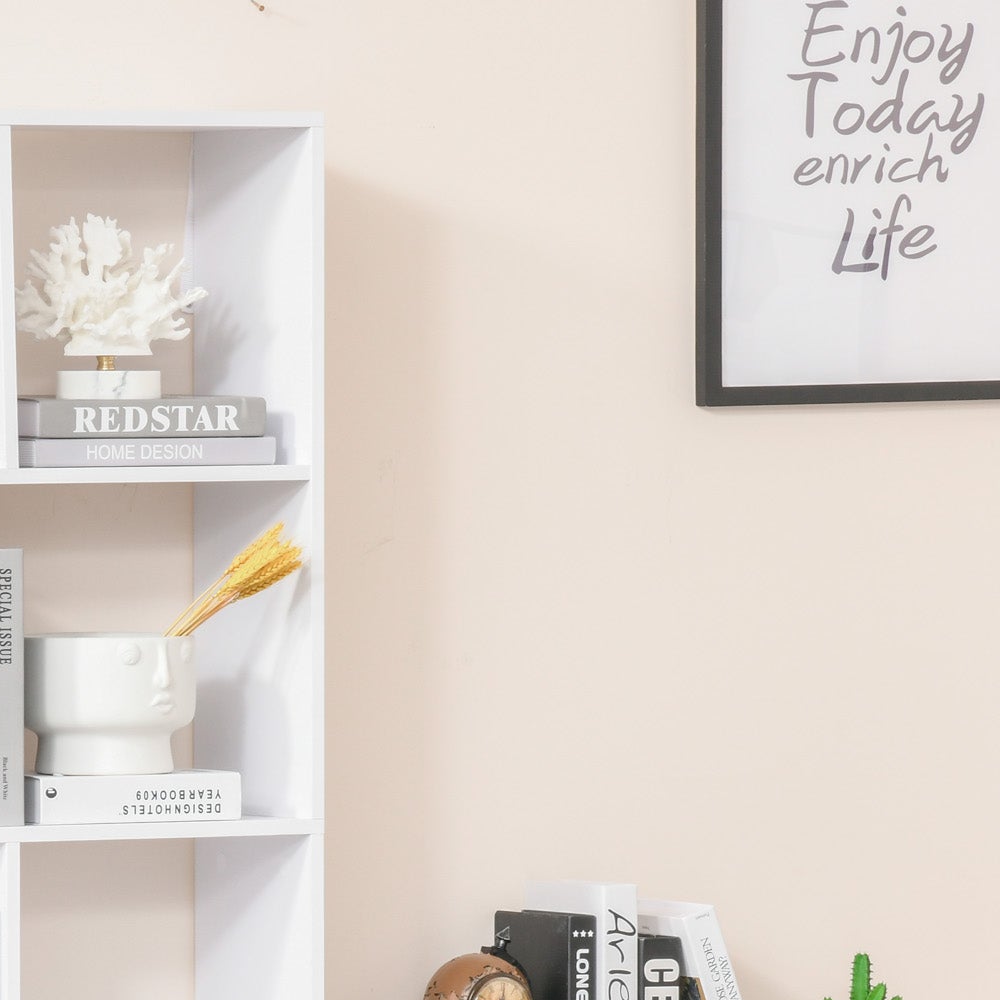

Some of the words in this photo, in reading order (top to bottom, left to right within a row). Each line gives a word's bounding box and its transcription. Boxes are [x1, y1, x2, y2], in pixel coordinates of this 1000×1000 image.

[801, 0, 974, 85] Enjoy
[787, 68, 985, 155] Today
[793, 133, 949, 186] enrich
[832, 193, 938, 281] Life
[73, 405, 240, 433] REDSTAR
[87, 445, 135, 460] HOME
[0, 568, 12, 623] SPECIAL
[0, 628, 12, 665] ISSUE
[122, 803, 222, 816] DESIGNHOTELS
[136, 788, 222, 800] YEARBOOK09
[700, 937, 720, 983] GARDEN
[718, 955, 740, 1000] ANYWAY?
